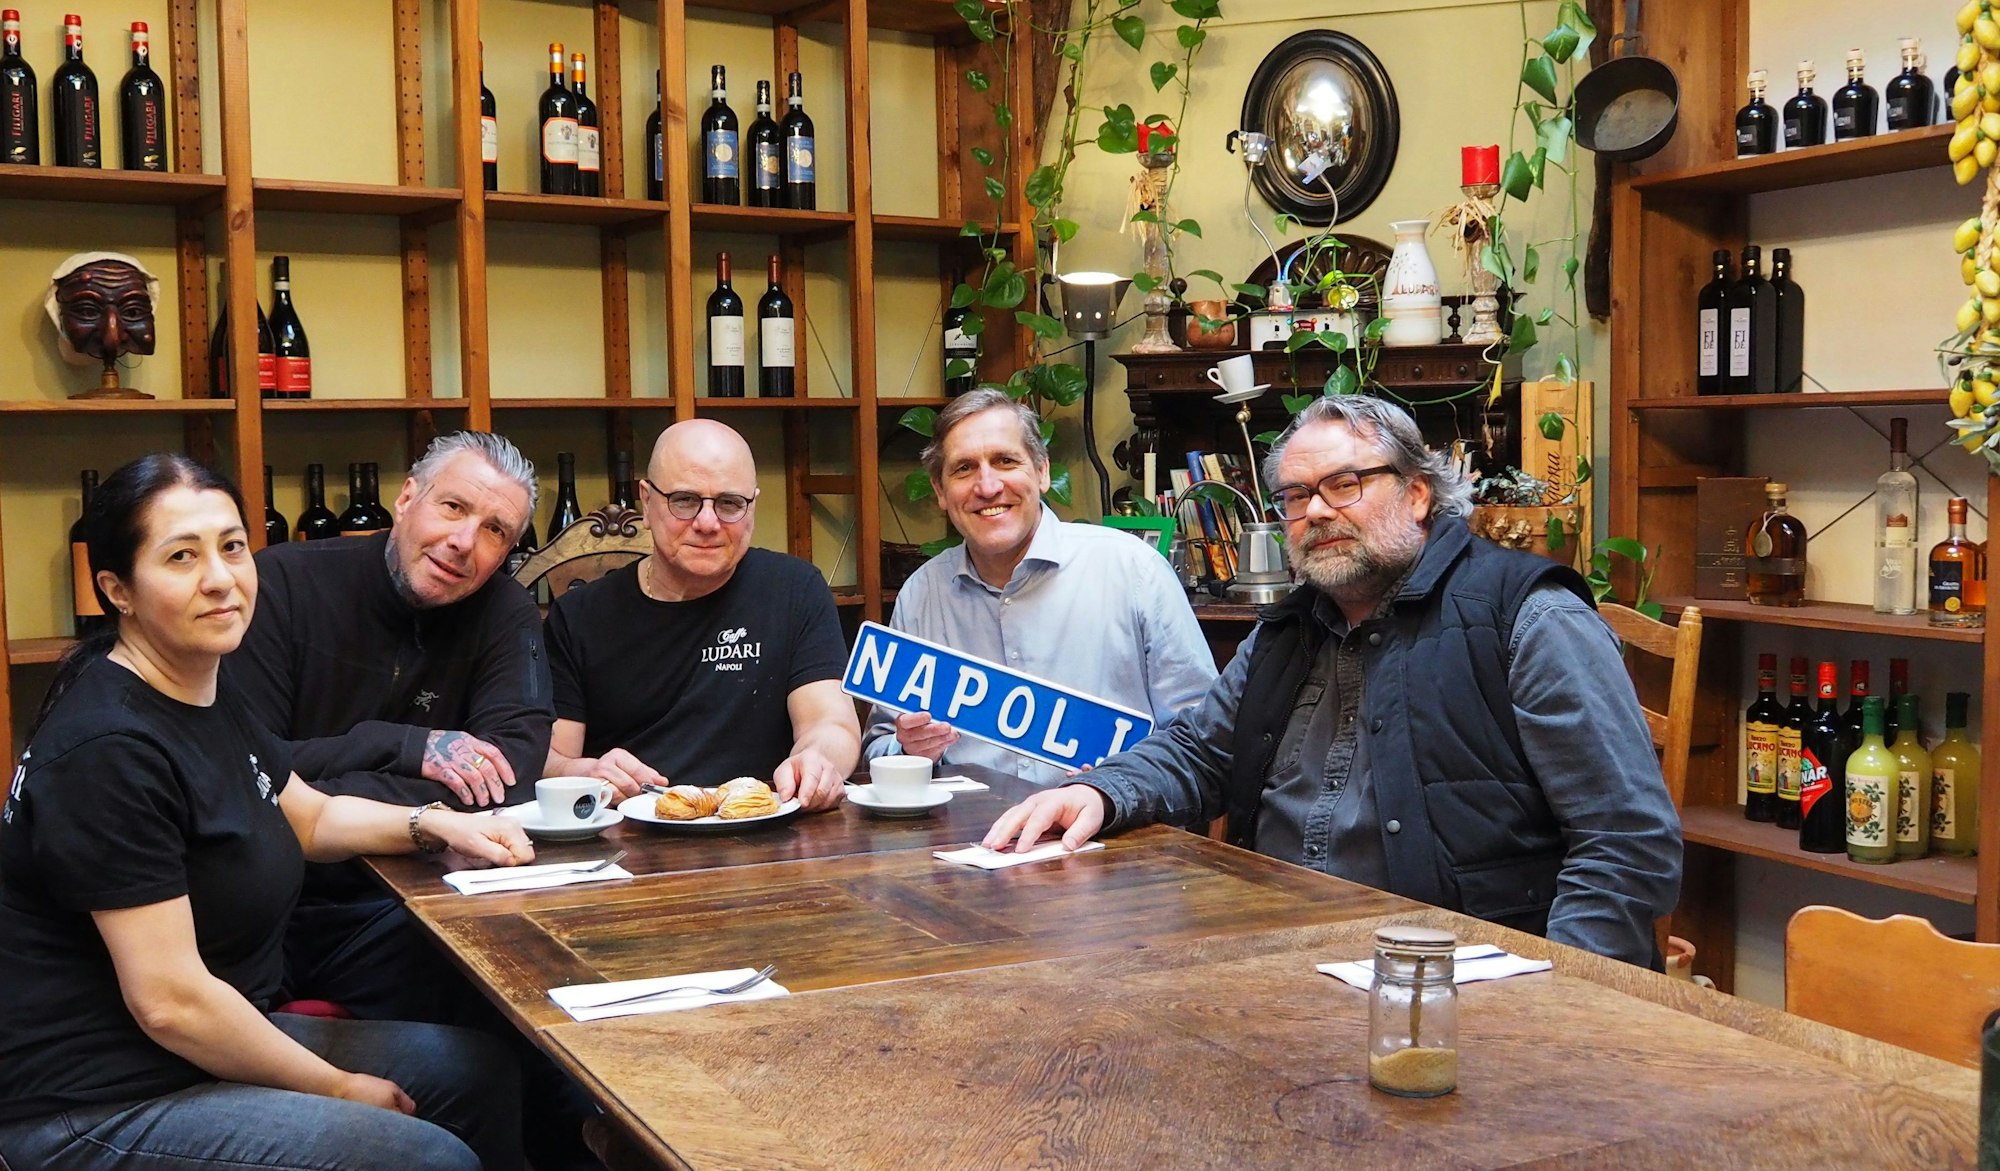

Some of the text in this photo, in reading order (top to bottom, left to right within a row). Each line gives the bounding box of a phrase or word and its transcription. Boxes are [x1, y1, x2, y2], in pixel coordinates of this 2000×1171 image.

[1704, 330, 1714, 342] FI
[1735, 330, 1745, 342] FI
[701, 642, 761, 663] LUDARI
[715, 663, 743, 671] NAPOLI
[852, 634, 1134, 767] NAPOLI
